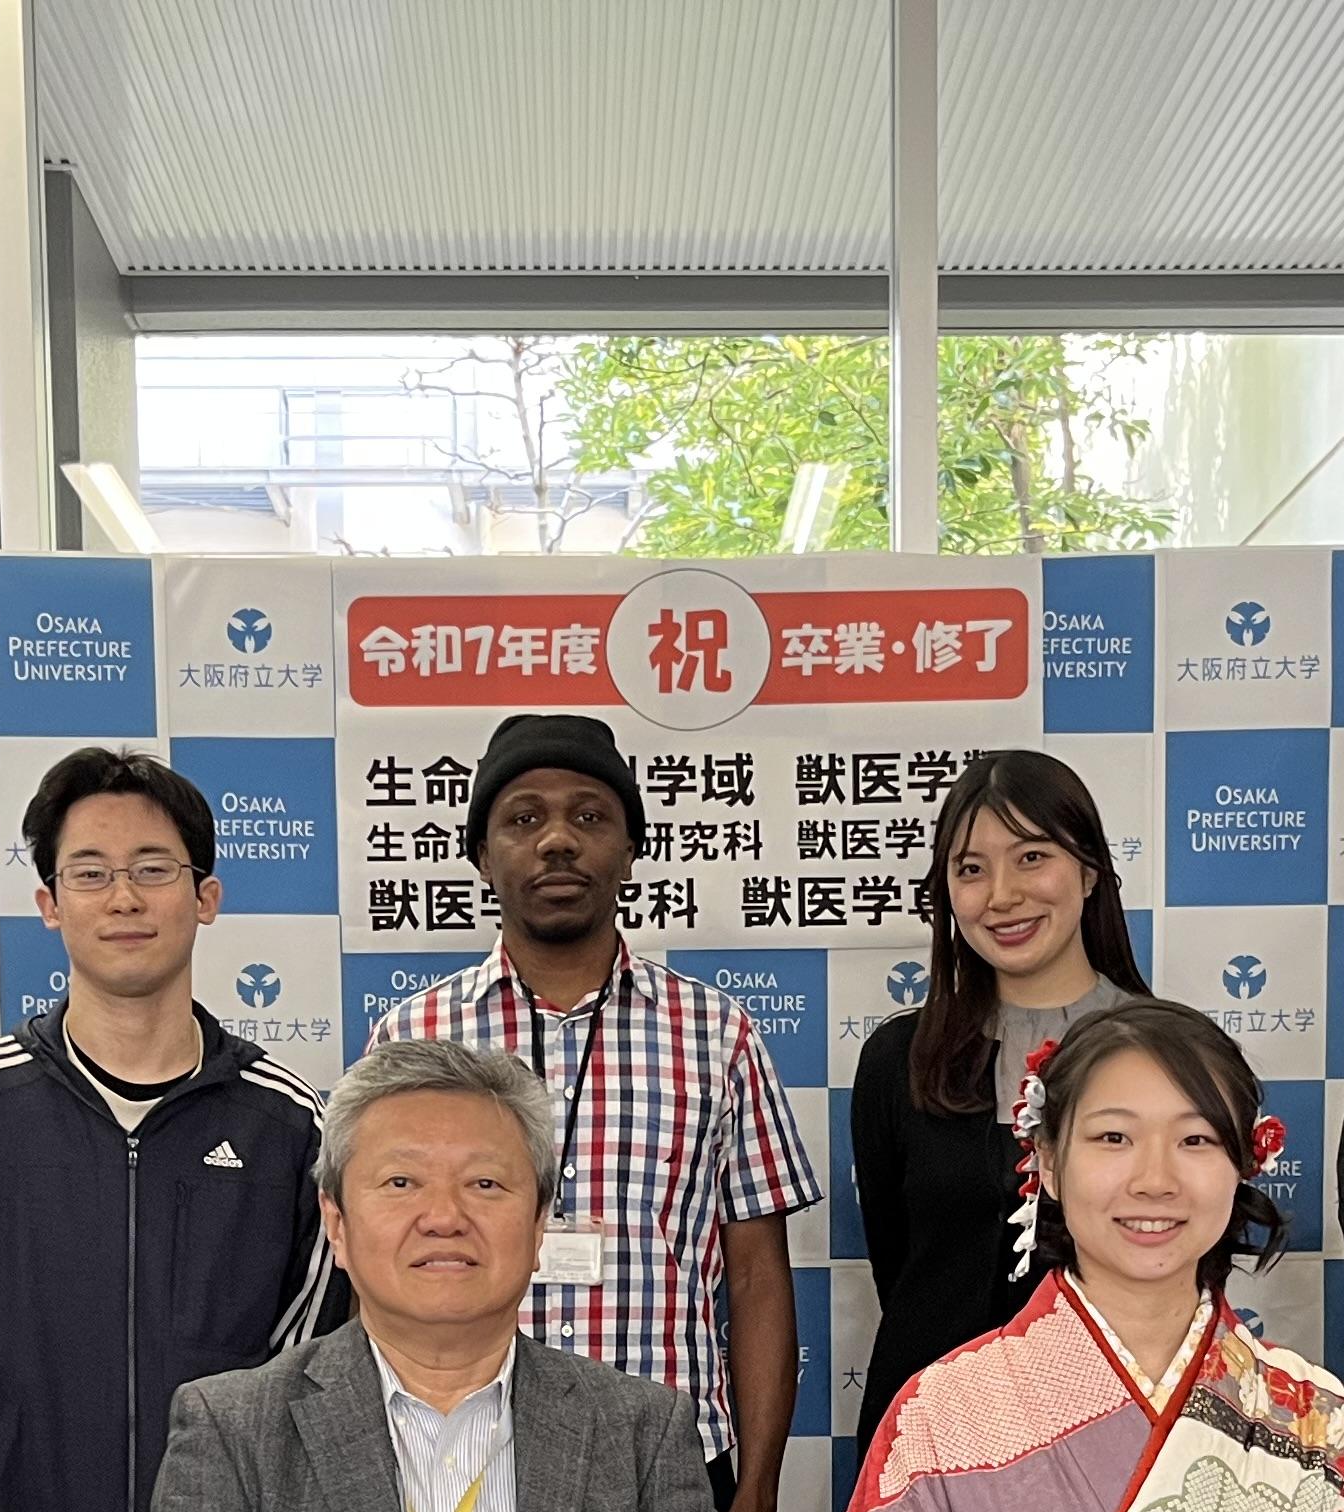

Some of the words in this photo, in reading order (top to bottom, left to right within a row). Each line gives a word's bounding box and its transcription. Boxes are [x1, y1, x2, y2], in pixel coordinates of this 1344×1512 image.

[37, 613, 102, 633] OSAKA
[1043, 611, 1104, 631] OSAKA
[9, 637, 131, 657] PREFECTURE
[360, 622, 600, 678] 令和7年度
[646, 608, 733, 694] 祝
[781, 618, 1013, 676] 卒業・修了
[1043, 637, 1132, 655] EFECTURE
[15, 661, 126, 681] UNIVERSITY
[179, 664, 322, 688] 大阪府立大学
[1043, 661, 1127, 678] IVERSITY
[1177, 655, 1320, 681] 大阪府立大学
[222, 793, 286, 812] OSAKA
[1216, 786, 1278, 805] OSAKA
[213, 819, 315, 836] REFECTURE
[1188, 810, 1305, 829] PREFECTURE
[798, 817, 937, 860] 獣医学
[1192, 833, 1300, 851] UNIVERSITY
[216, 843, 310, 859] NIVERSITY
[716, 969, 777, 988] OSAKA
[739, 995, 805, 1011] ECTURE
[220, 1018, 330, 1043] 府立大学
[1203, 1008, 1315, 1033] 府立大学
